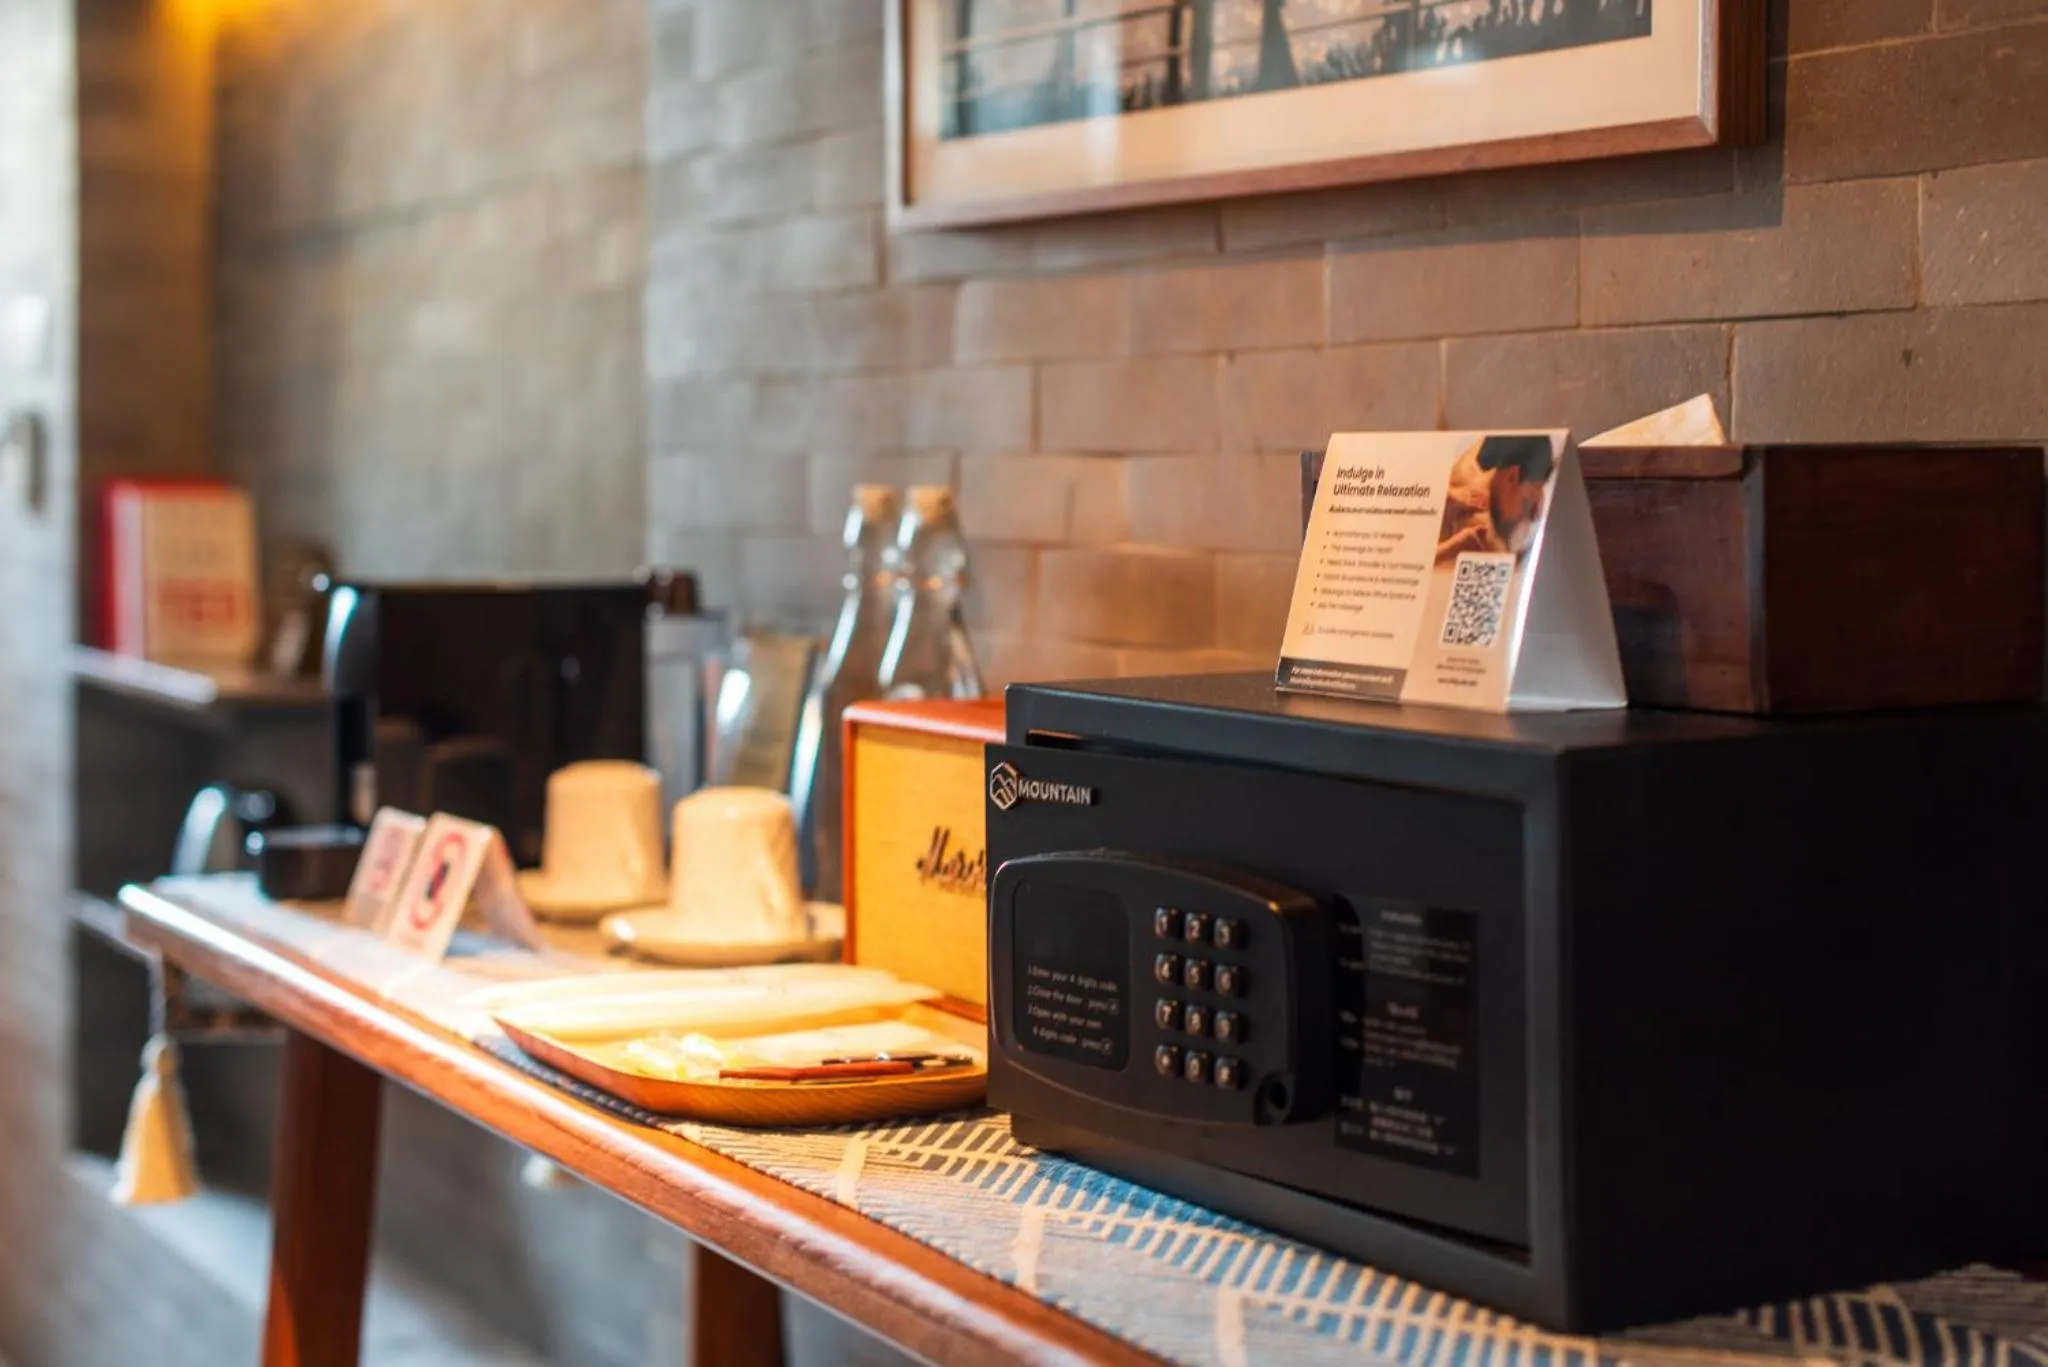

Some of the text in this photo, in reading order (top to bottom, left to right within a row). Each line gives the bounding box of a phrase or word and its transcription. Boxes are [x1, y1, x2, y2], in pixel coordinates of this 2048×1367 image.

[1336, 465, 1385, 483] Indulge in
[1333, 483, 1431, 498] Ultimate Relaxation
[1018, 779, 1092, 805] MOUNTAIN
